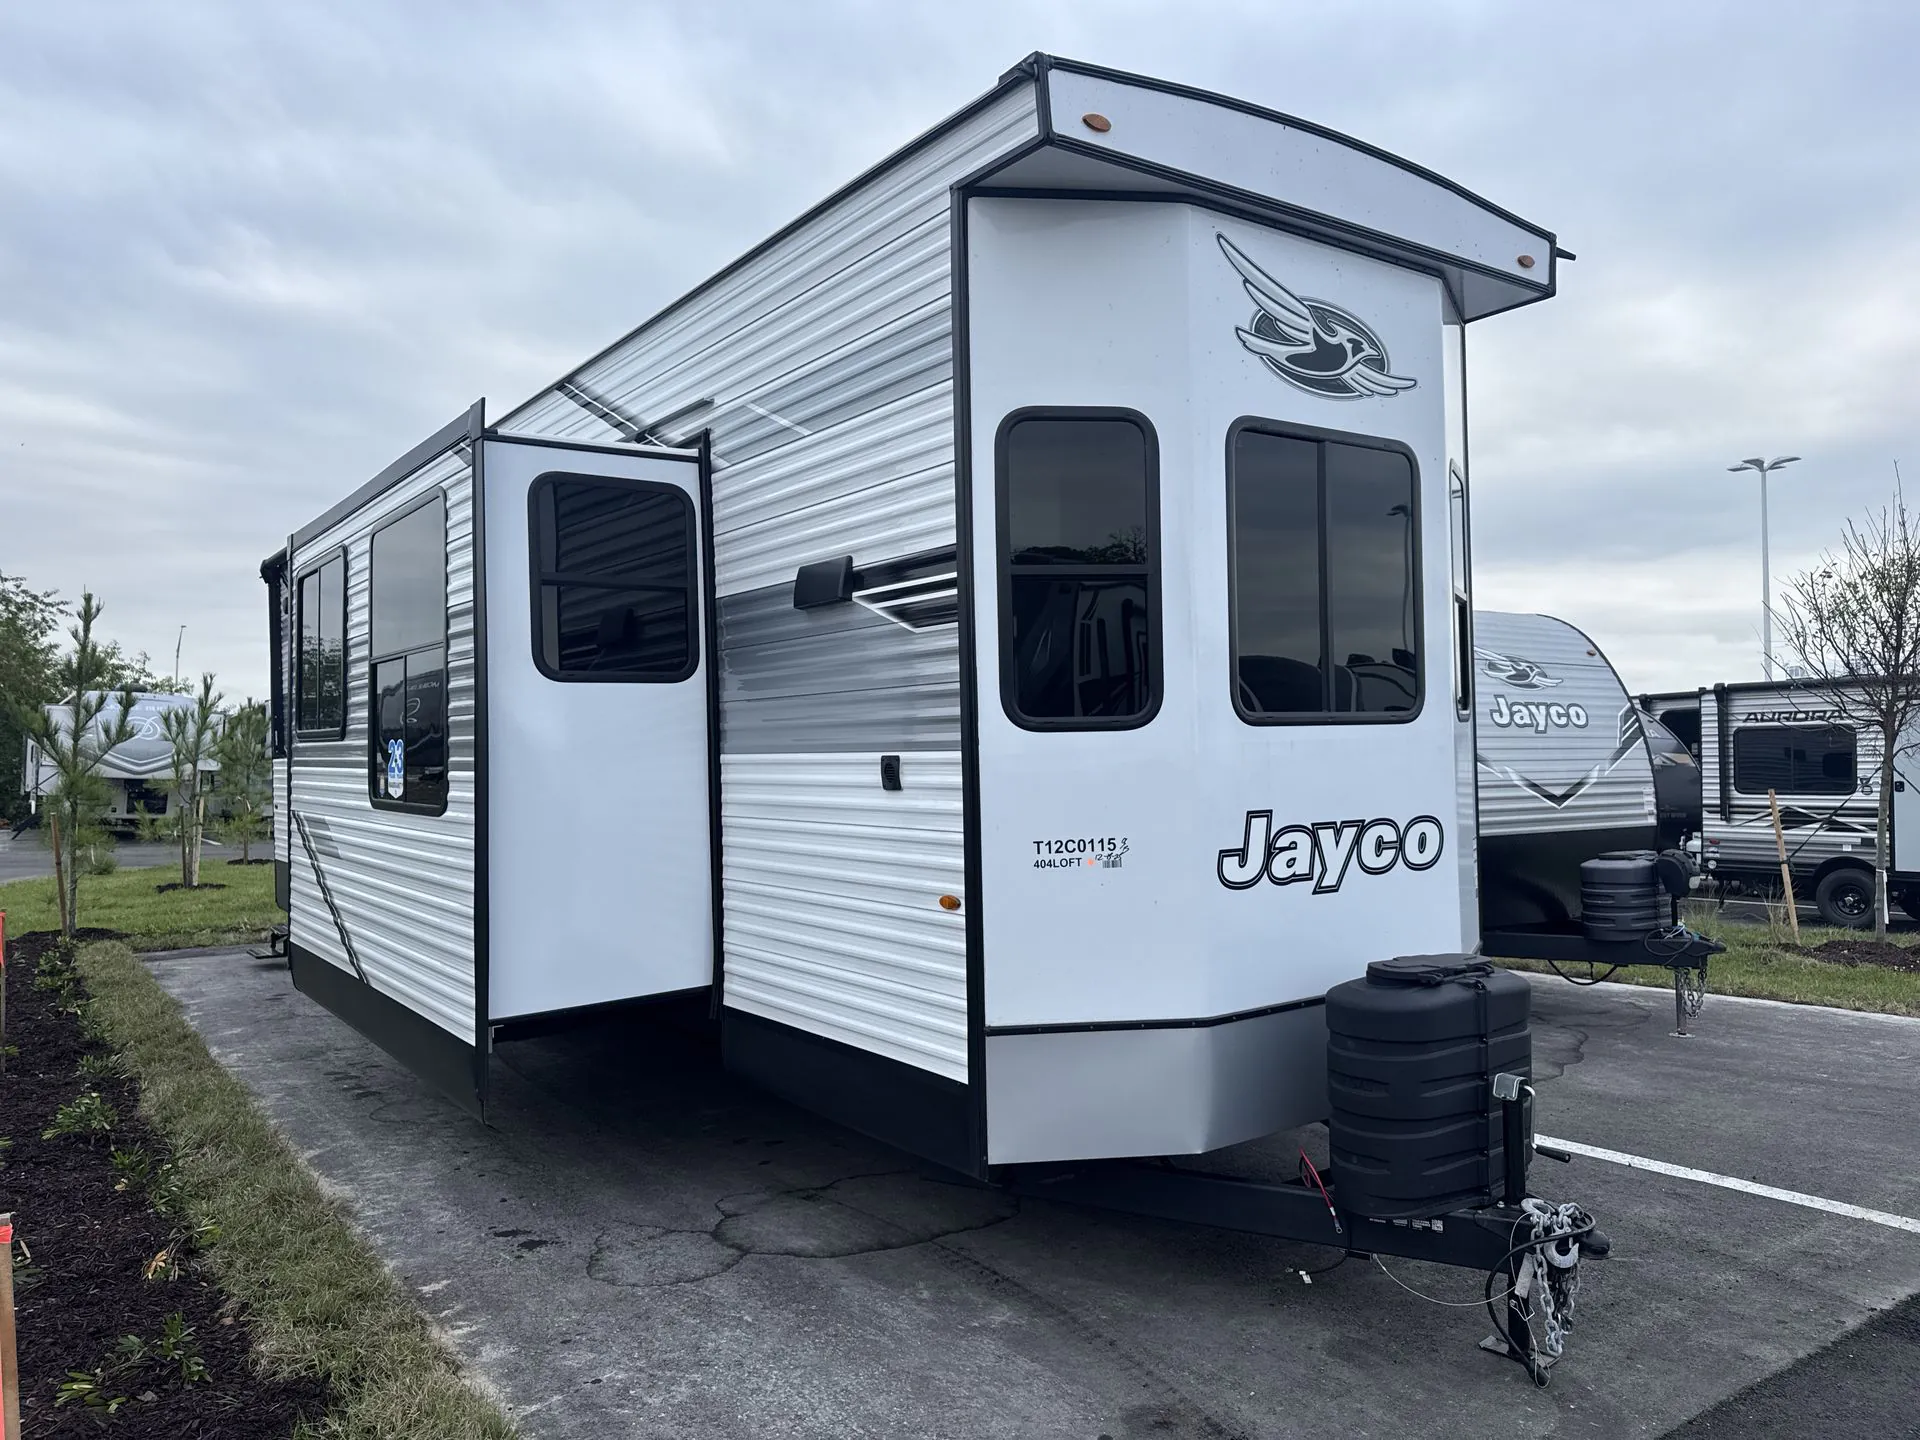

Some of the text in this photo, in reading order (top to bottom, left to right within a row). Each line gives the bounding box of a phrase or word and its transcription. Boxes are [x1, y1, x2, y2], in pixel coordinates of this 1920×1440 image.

[1490, 694, 1589, 734] Jayco
[1742, 709, 1845, 723] AURORA
[1033, 837, 1117, 855] T12C0115
[1216, 809, 1444, 895] Jayco
[1033, 857, 1083, 869] 404LOFT
